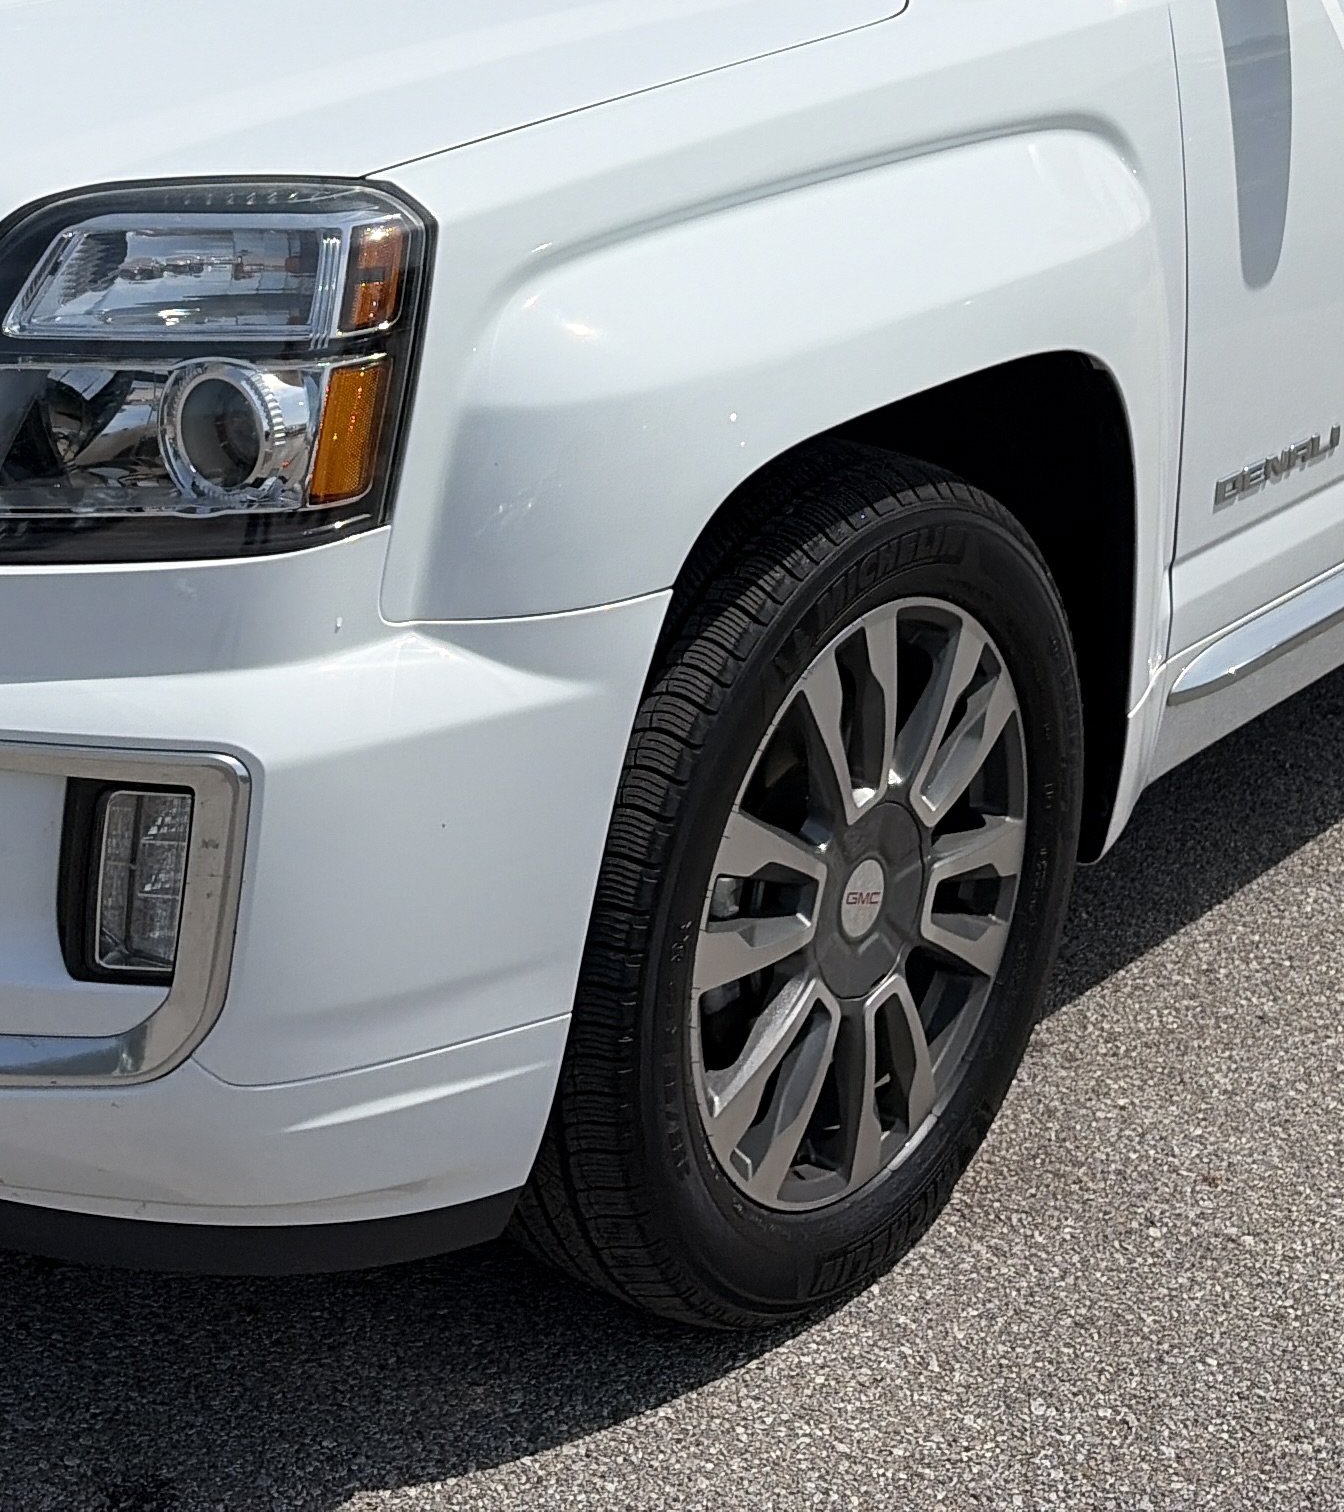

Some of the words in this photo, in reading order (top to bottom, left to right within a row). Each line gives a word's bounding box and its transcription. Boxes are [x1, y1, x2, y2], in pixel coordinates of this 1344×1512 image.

[1213, 423, 1341, 508] DENALI
[816, 524, 966, 633] MICHELIN
[846, 891, 881, 905] GMC
